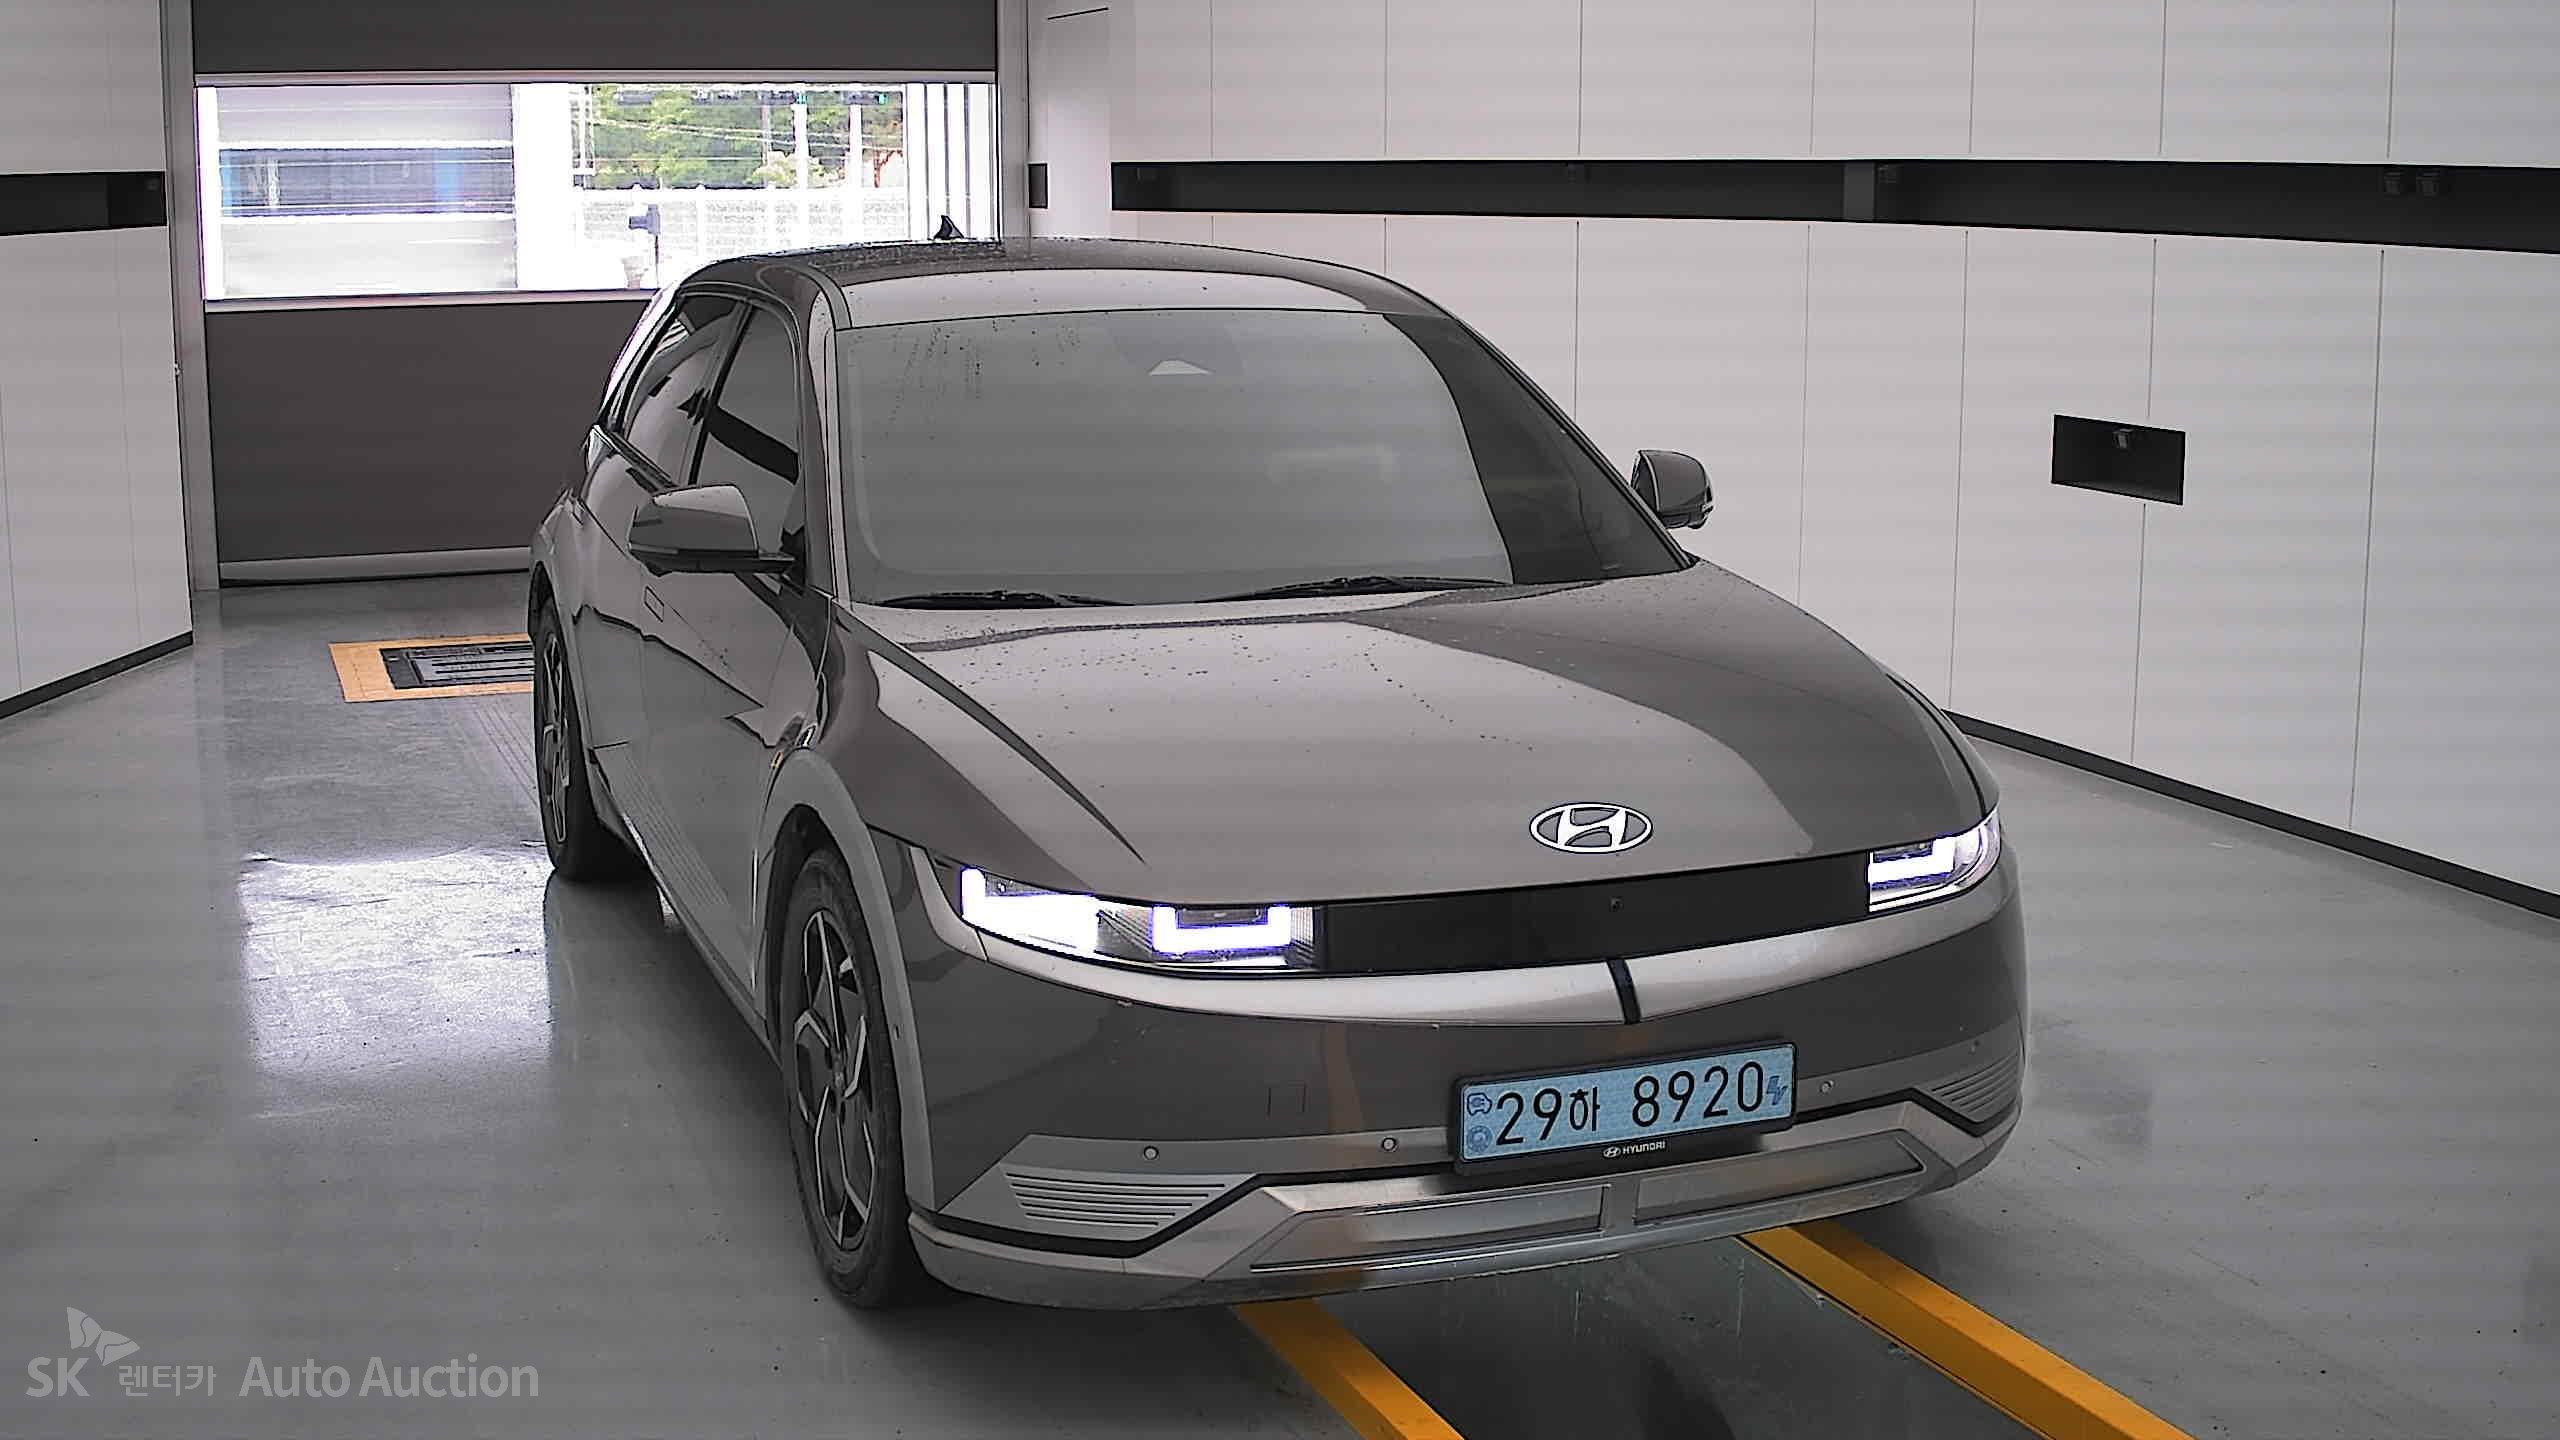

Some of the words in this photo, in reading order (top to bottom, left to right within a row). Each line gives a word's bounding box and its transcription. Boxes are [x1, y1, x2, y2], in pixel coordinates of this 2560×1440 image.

[1496, 1087, 1600, 1145] 29하
[1632, 1061, 1764, 1127] 8920
[1622, 1141, 1666, 1154] HYUNDAI
